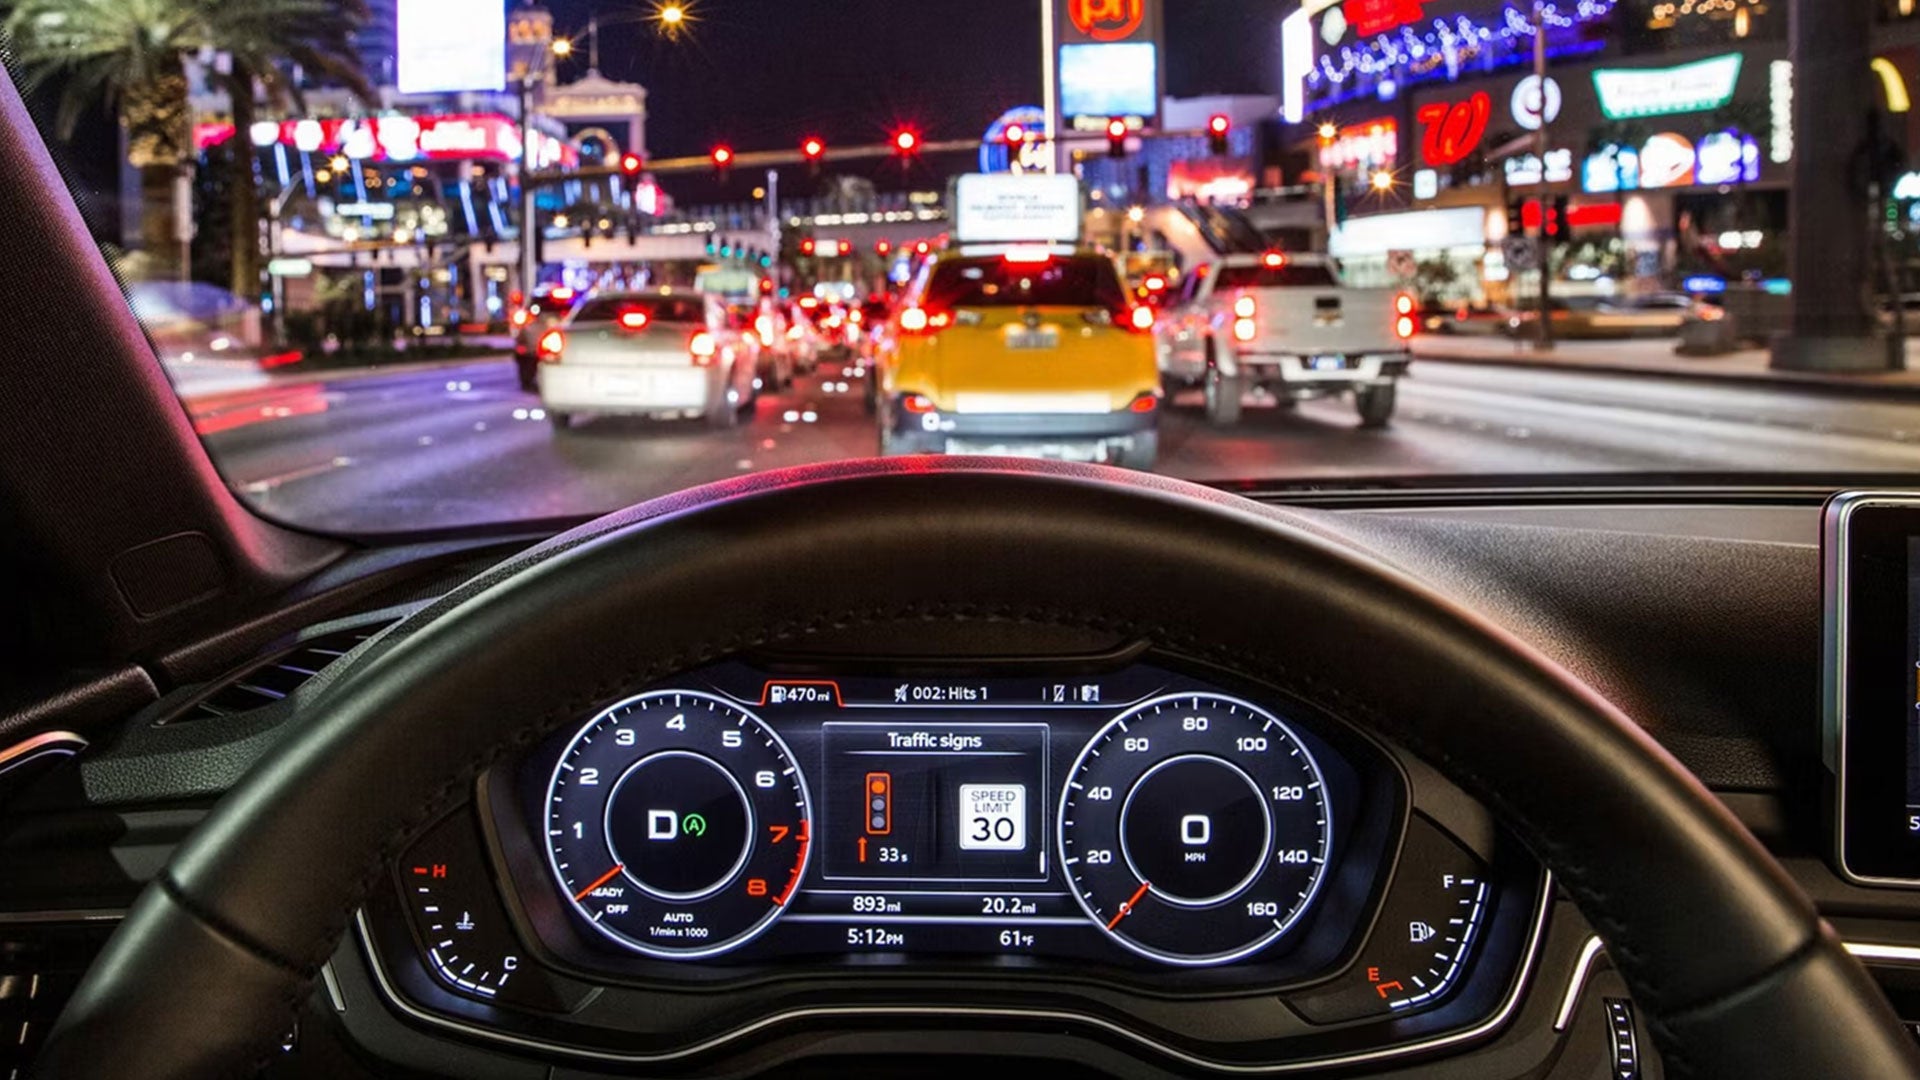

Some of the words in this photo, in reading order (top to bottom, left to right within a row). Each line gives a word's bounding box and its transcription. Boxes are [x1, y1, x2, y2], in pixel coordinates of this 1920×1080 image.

[912, 686, 945, 700] 002:
[948, 686, 977, 700] Hits
[980, 686, 988, 700] 1
[665, 713, 687, 732] 4
[1182, 716, 1209, 732] 80
[615, 728, 636, 746] 3
[722, 730, 743, 748] 5
[887, 731, 938, 748] Traffic
[939, 732, 983, 750] signs
[1123, 737, 1150, 752] 60
[1236, 737, 1268, 752] 100
[579, 767, 599, 786] 2
[755, 770, 776, 788] 6
[971, 790, 1017, 802] SPEED
[1087, 786, 1113, 801] 40
[1272, 786, 1304, 801] 120
[974, 803, 1012, 813] LIMIT
[572, 821, 584, 839] 1
[648, 809, 678, 840] D
[972, 817, 1015, 842] 30
[1180, 814, 1211, 845] 0
[769, 825, 790, 844] 7
[879, 847, 900, 862] 33
[1086, 849, 1112, 864] 20
[1184, 852, 1206, 862] MPH
[1277, 849, 1309, 864] 140
[432, 864, 447, 878] H
[746, 878, 768, 896] 8
[1443, 874, 1454, 888] F
[587, 883, 624, 897] EADY
[605, 904, 629, 915] OFF
[1246, 902, 1278, 916] 160
[662, 912, 694, 923] AUTO
[649, 926, 676, 937] 1/min
[677, 929, 683, 937] x
[685, 927, 709, 938] 1000
[504, 956, 517, 970] C
[1367, 967, 1380, 981] E
